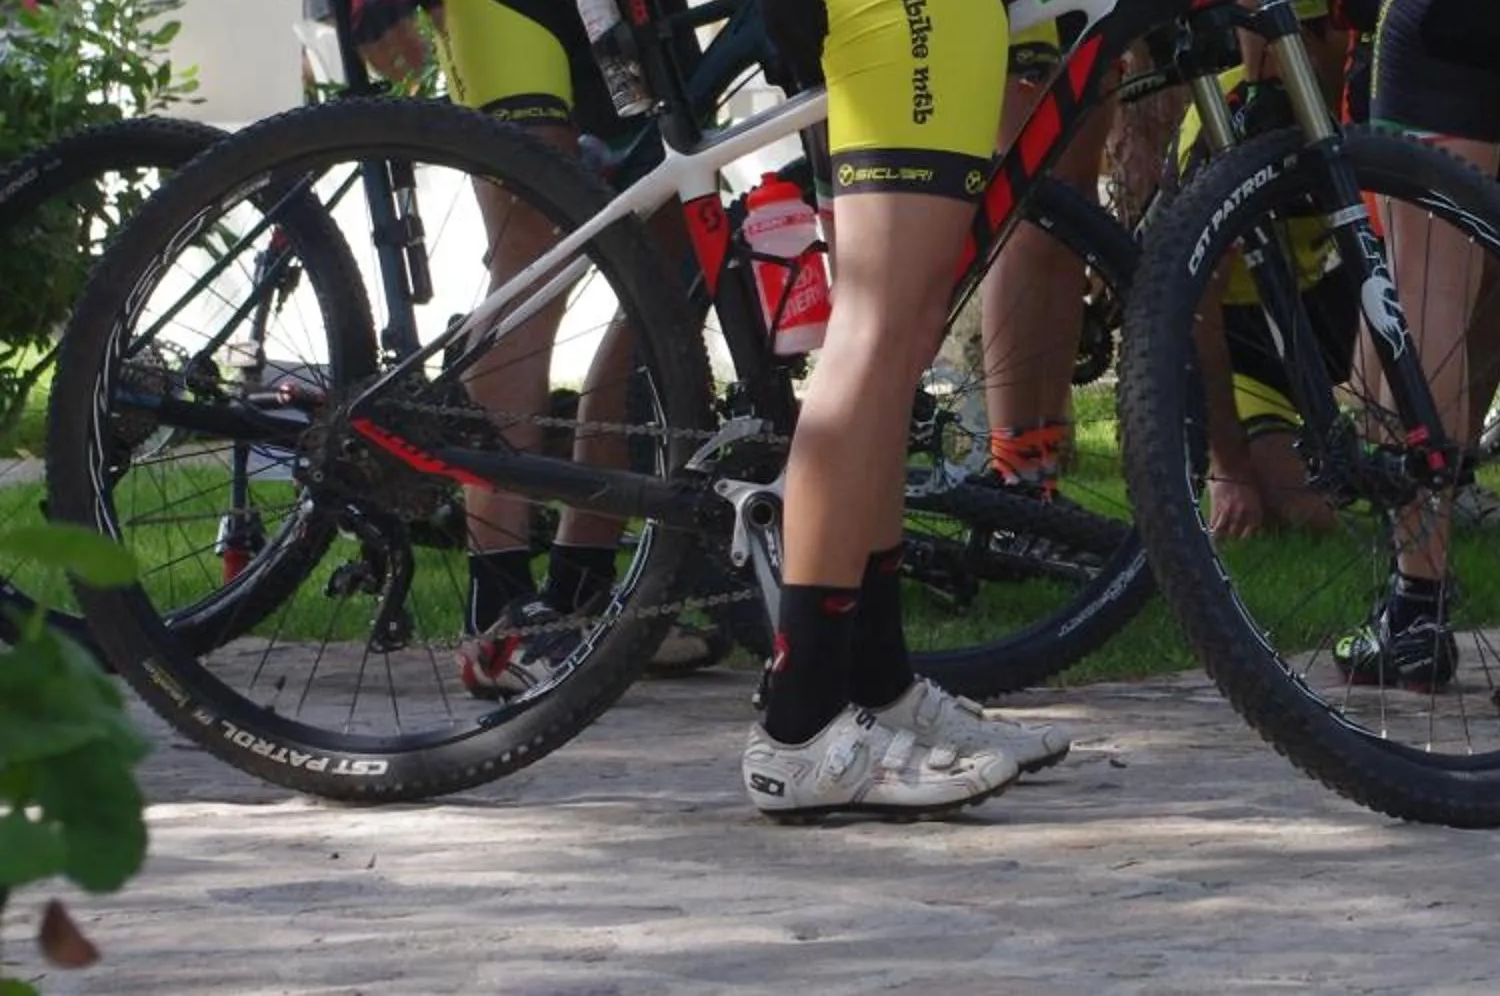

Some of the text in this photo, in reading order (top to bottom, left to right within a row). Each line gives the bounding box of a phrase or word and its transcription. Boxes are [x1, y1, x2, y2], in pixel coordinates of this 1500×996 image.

[1211, 164, 1281, 232] PATROL
[220, 718, 390, 776] CST PATROL
